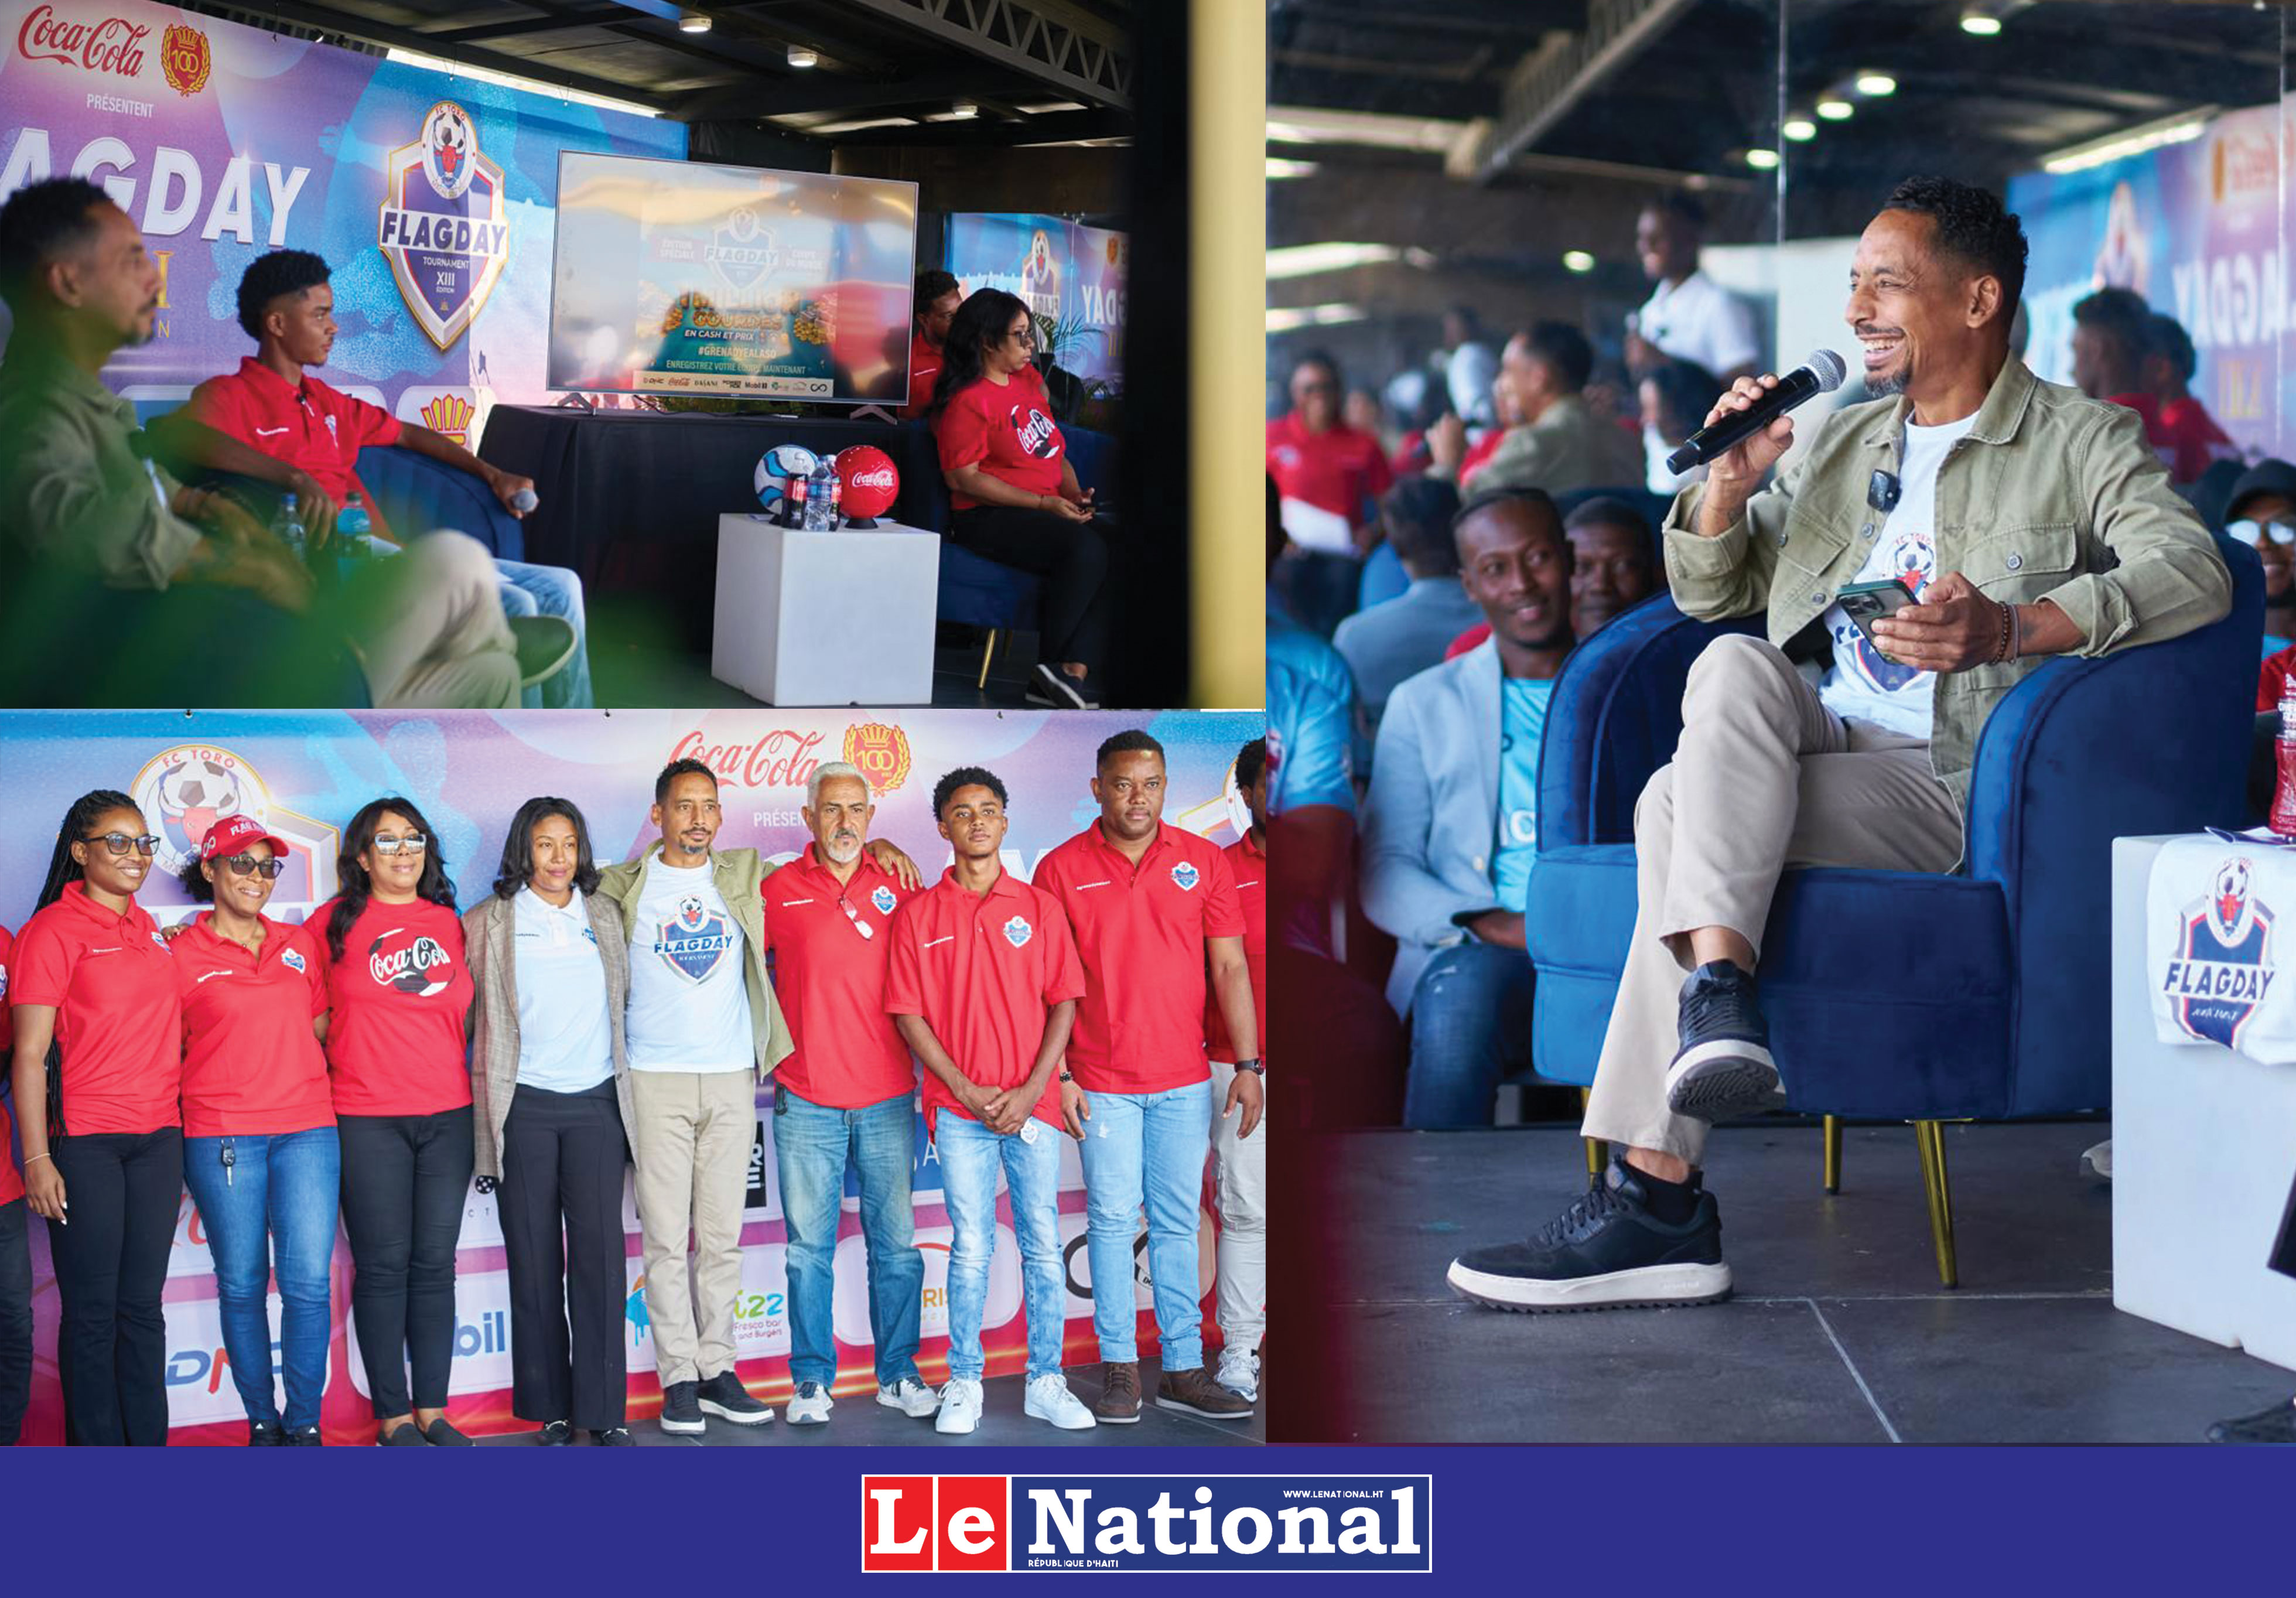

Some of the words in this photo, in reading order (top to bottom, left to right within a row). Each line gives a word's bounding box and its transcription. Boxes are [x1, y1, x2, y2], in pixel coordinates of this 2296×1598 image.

[18, 4, 152, 77] Coca-Cola
[171, 49, 199, 73] 100
[87, 93, 153, 118] PRÉSENTENT
[381, 211, 507, 255] FLAGDAY
[423, 256, 469, 269] TOURNAMENT
[705, 247, 778, 264] FLAGDAY
[436, 271, 456, 286] XIII
[684, 329, 696, 337] EN
[698, 330, 721, 339] CASH
[723, 331, 733, 339] ET
[734, 332, 754, 341] PRIX
[666, 359, 713, 370] ENREGISTREZ
[763, 364, 806, 375] MAINTENANT
[1017, 409, 1055, 455] Coca-Cola
[163, 753, 180, 768] FC
[191, 749, 235, 769] TORO
[857, 750, 895, 771] 100
[754, 808, 806, 828] PRÉSEN
[654, 935, 733, 954] FLAGDAY
[370, 937, 451, 986] Coca-Cola
[2164, 962, 2274, 1001] FLAGDAY
[766, 1319, 783, 1328] bar
[453, 1311, 505, 1357] bil
